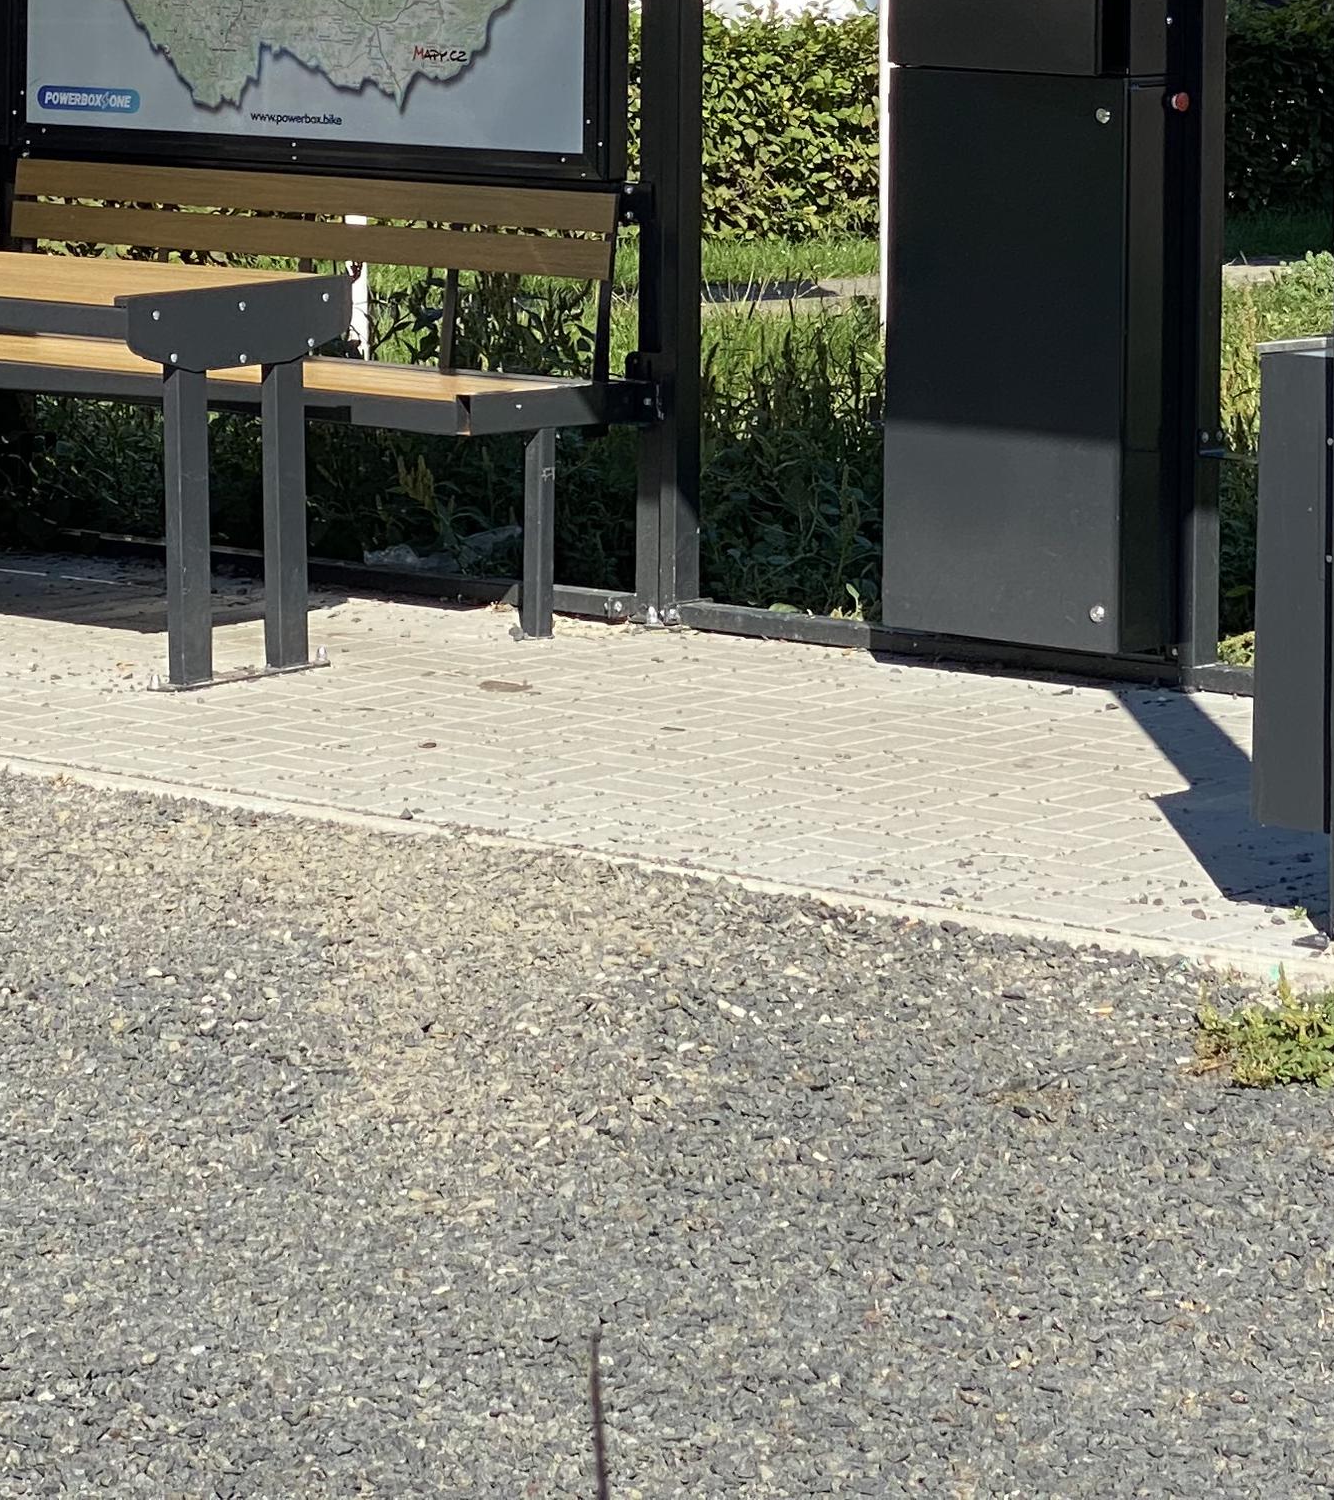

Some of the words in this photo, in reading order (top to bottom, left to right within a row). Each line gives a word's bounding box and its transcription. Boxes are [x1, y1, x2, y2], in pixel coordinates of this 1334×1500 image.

[44, 91, 103, 107] POWERBOX
[109, 94, 132, 108] ONE
[250, 112, 343, 126] www.powerbox.bike
